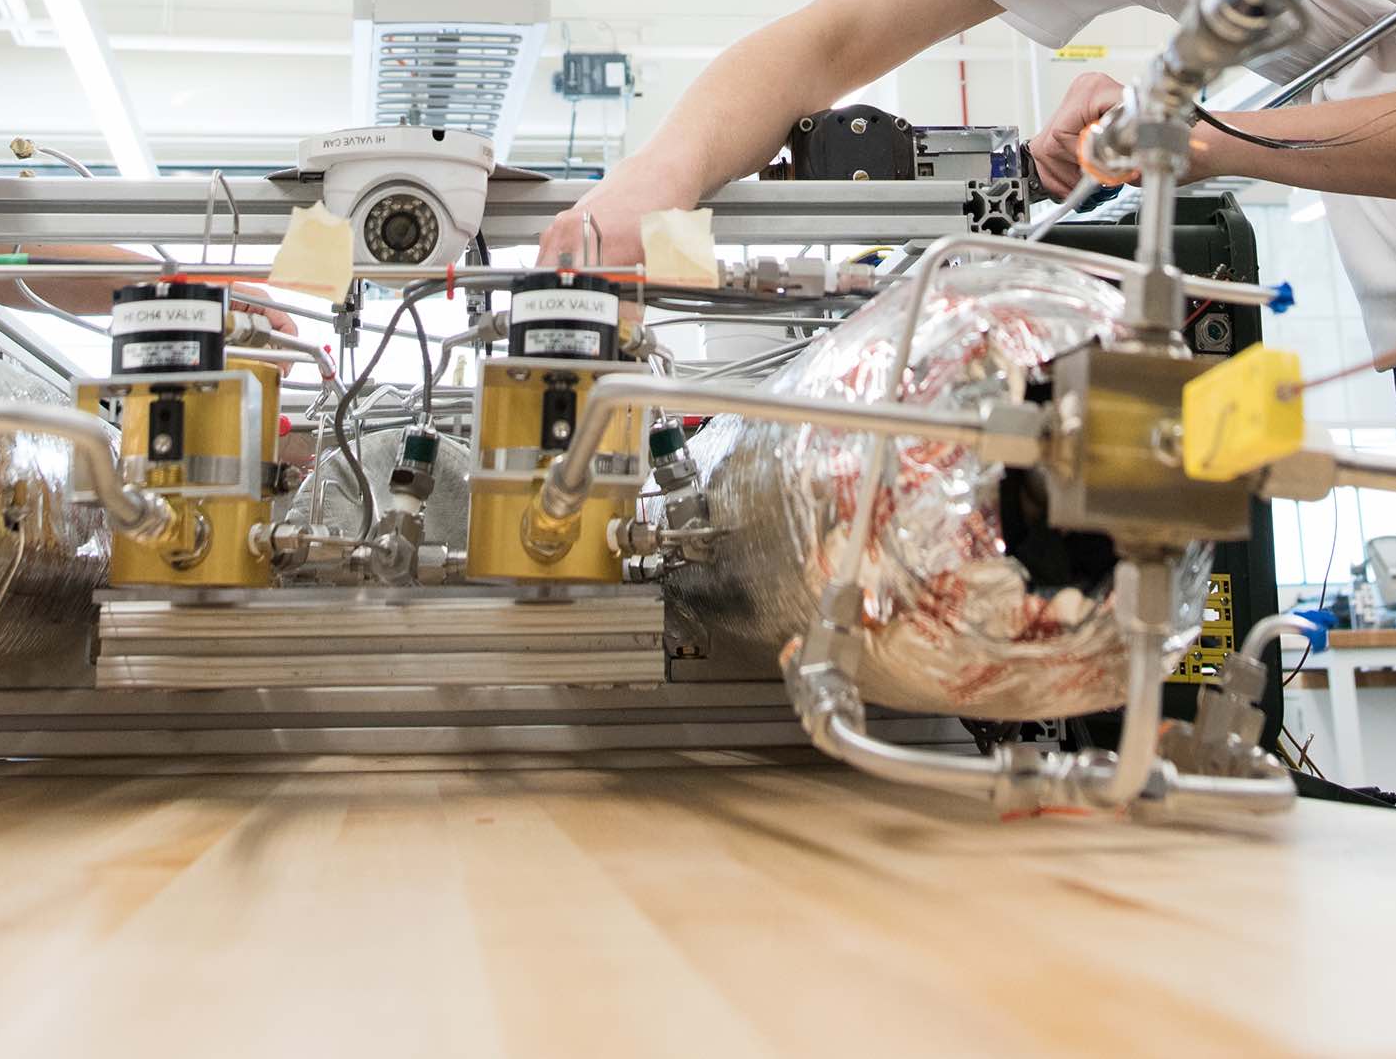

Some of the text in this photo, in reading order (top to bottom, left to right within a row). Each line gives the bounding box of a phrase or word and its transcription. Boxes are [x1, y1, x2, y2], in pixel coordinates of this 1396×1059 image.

[323, 134, 386, 149] HI VALVE CAM
[539, 299, 565, 310] LOX
[569, 299, 606, 313] VALVE
[166, 307, 207, 322] VALVE
